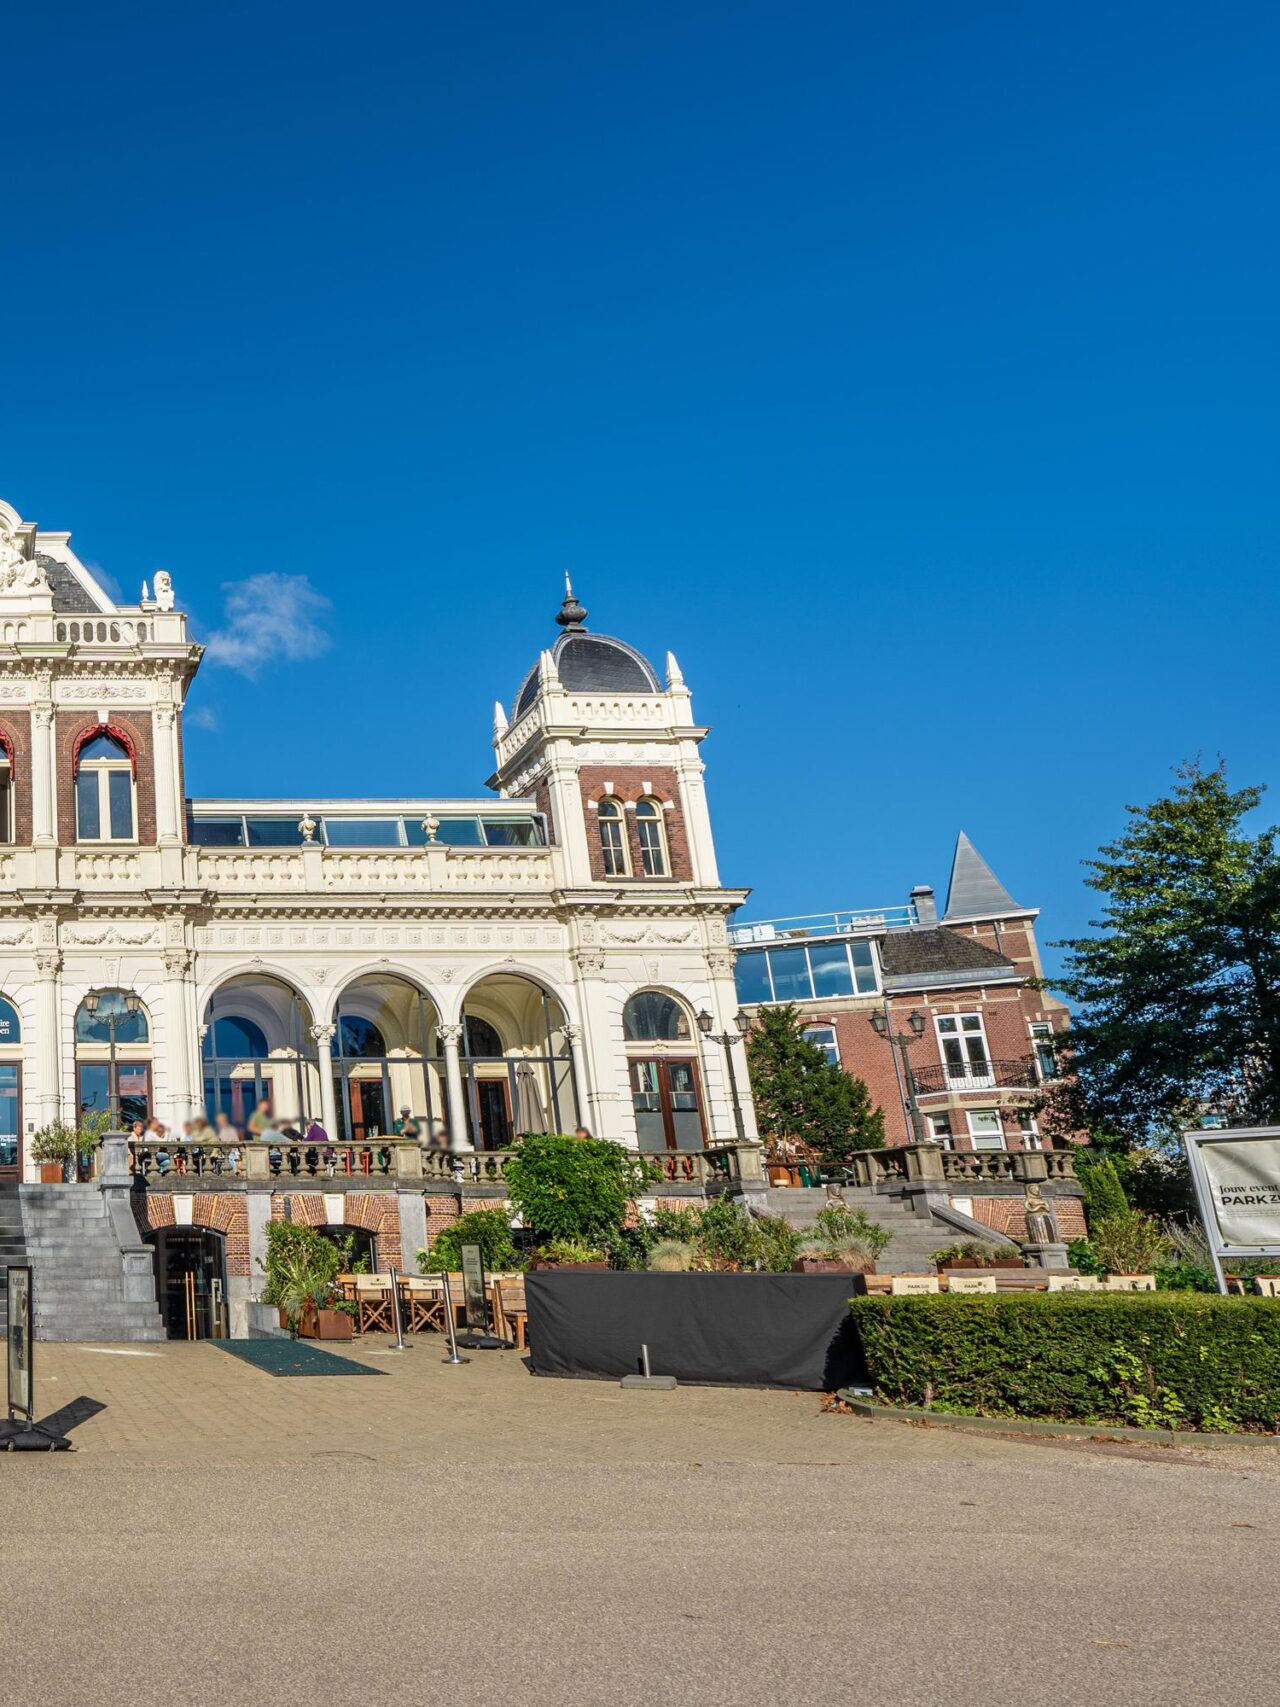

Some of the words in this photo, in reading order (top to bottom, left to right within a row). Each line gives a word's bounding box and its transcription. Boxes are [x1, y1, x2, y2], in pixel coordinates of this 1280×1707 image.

[1220, 1185, 1247, 1195] Jouw
[1249, 1184, 1279, 1192] event
[1221, 1195, 1268, 1206] PARK
